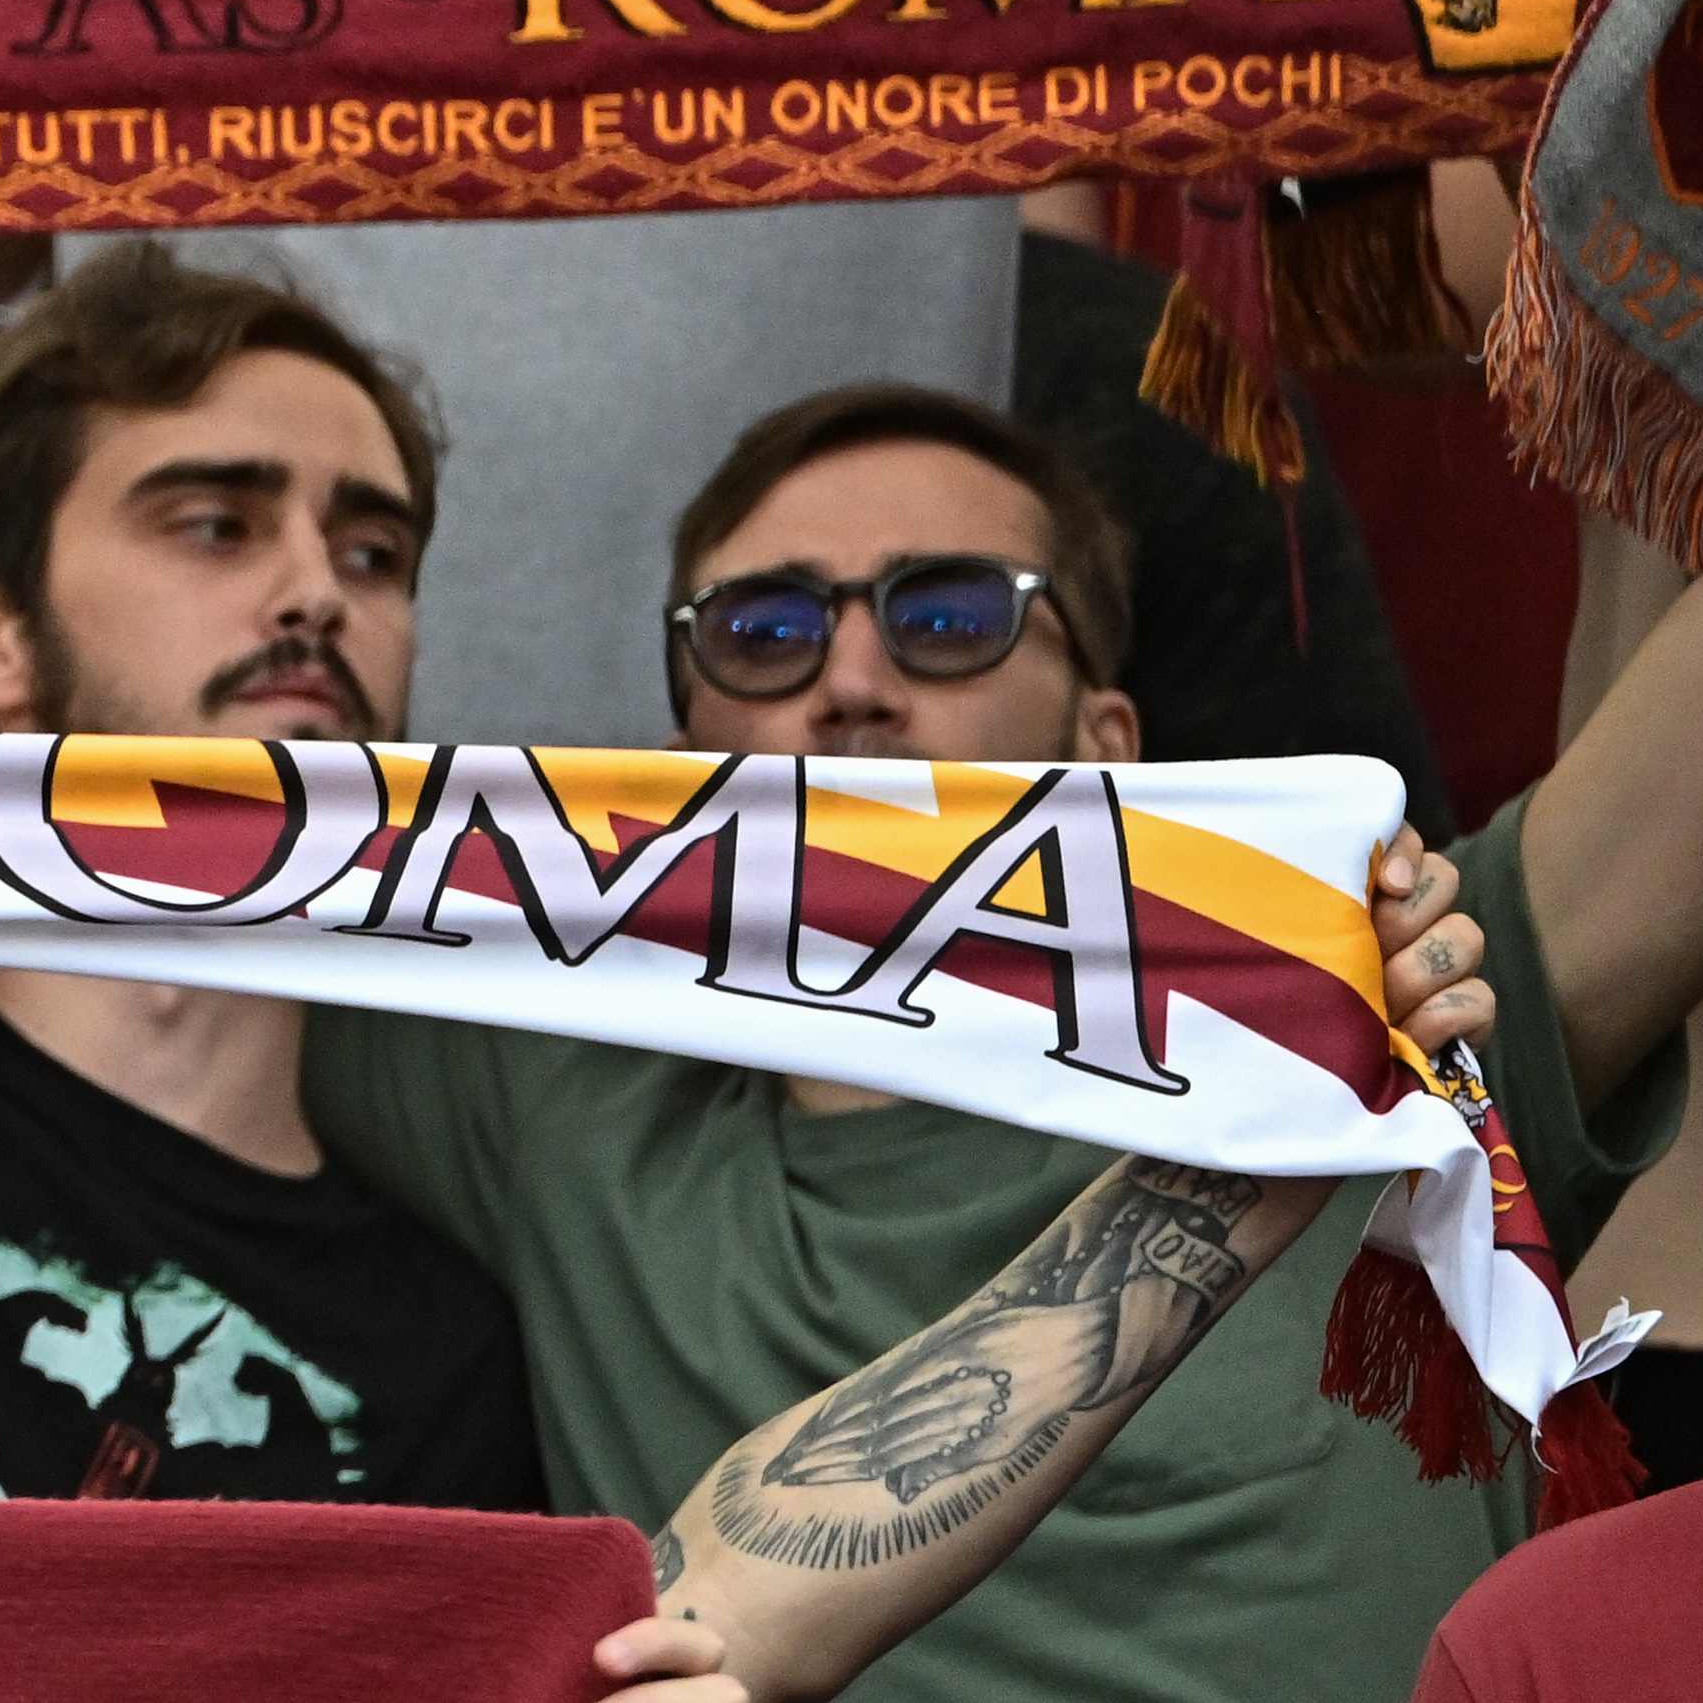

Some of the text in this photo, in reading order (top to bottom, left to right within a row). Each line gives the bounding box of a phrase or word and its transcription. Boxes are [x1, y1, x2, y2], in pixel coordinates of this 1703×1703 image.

[209, 97, 555, 162] RIUSCIRCI
[768, 71, 1020, 135] ONORE
[1043, 63, 1108, 119] DI
[1132, 52, 1343, 112] POCHI
